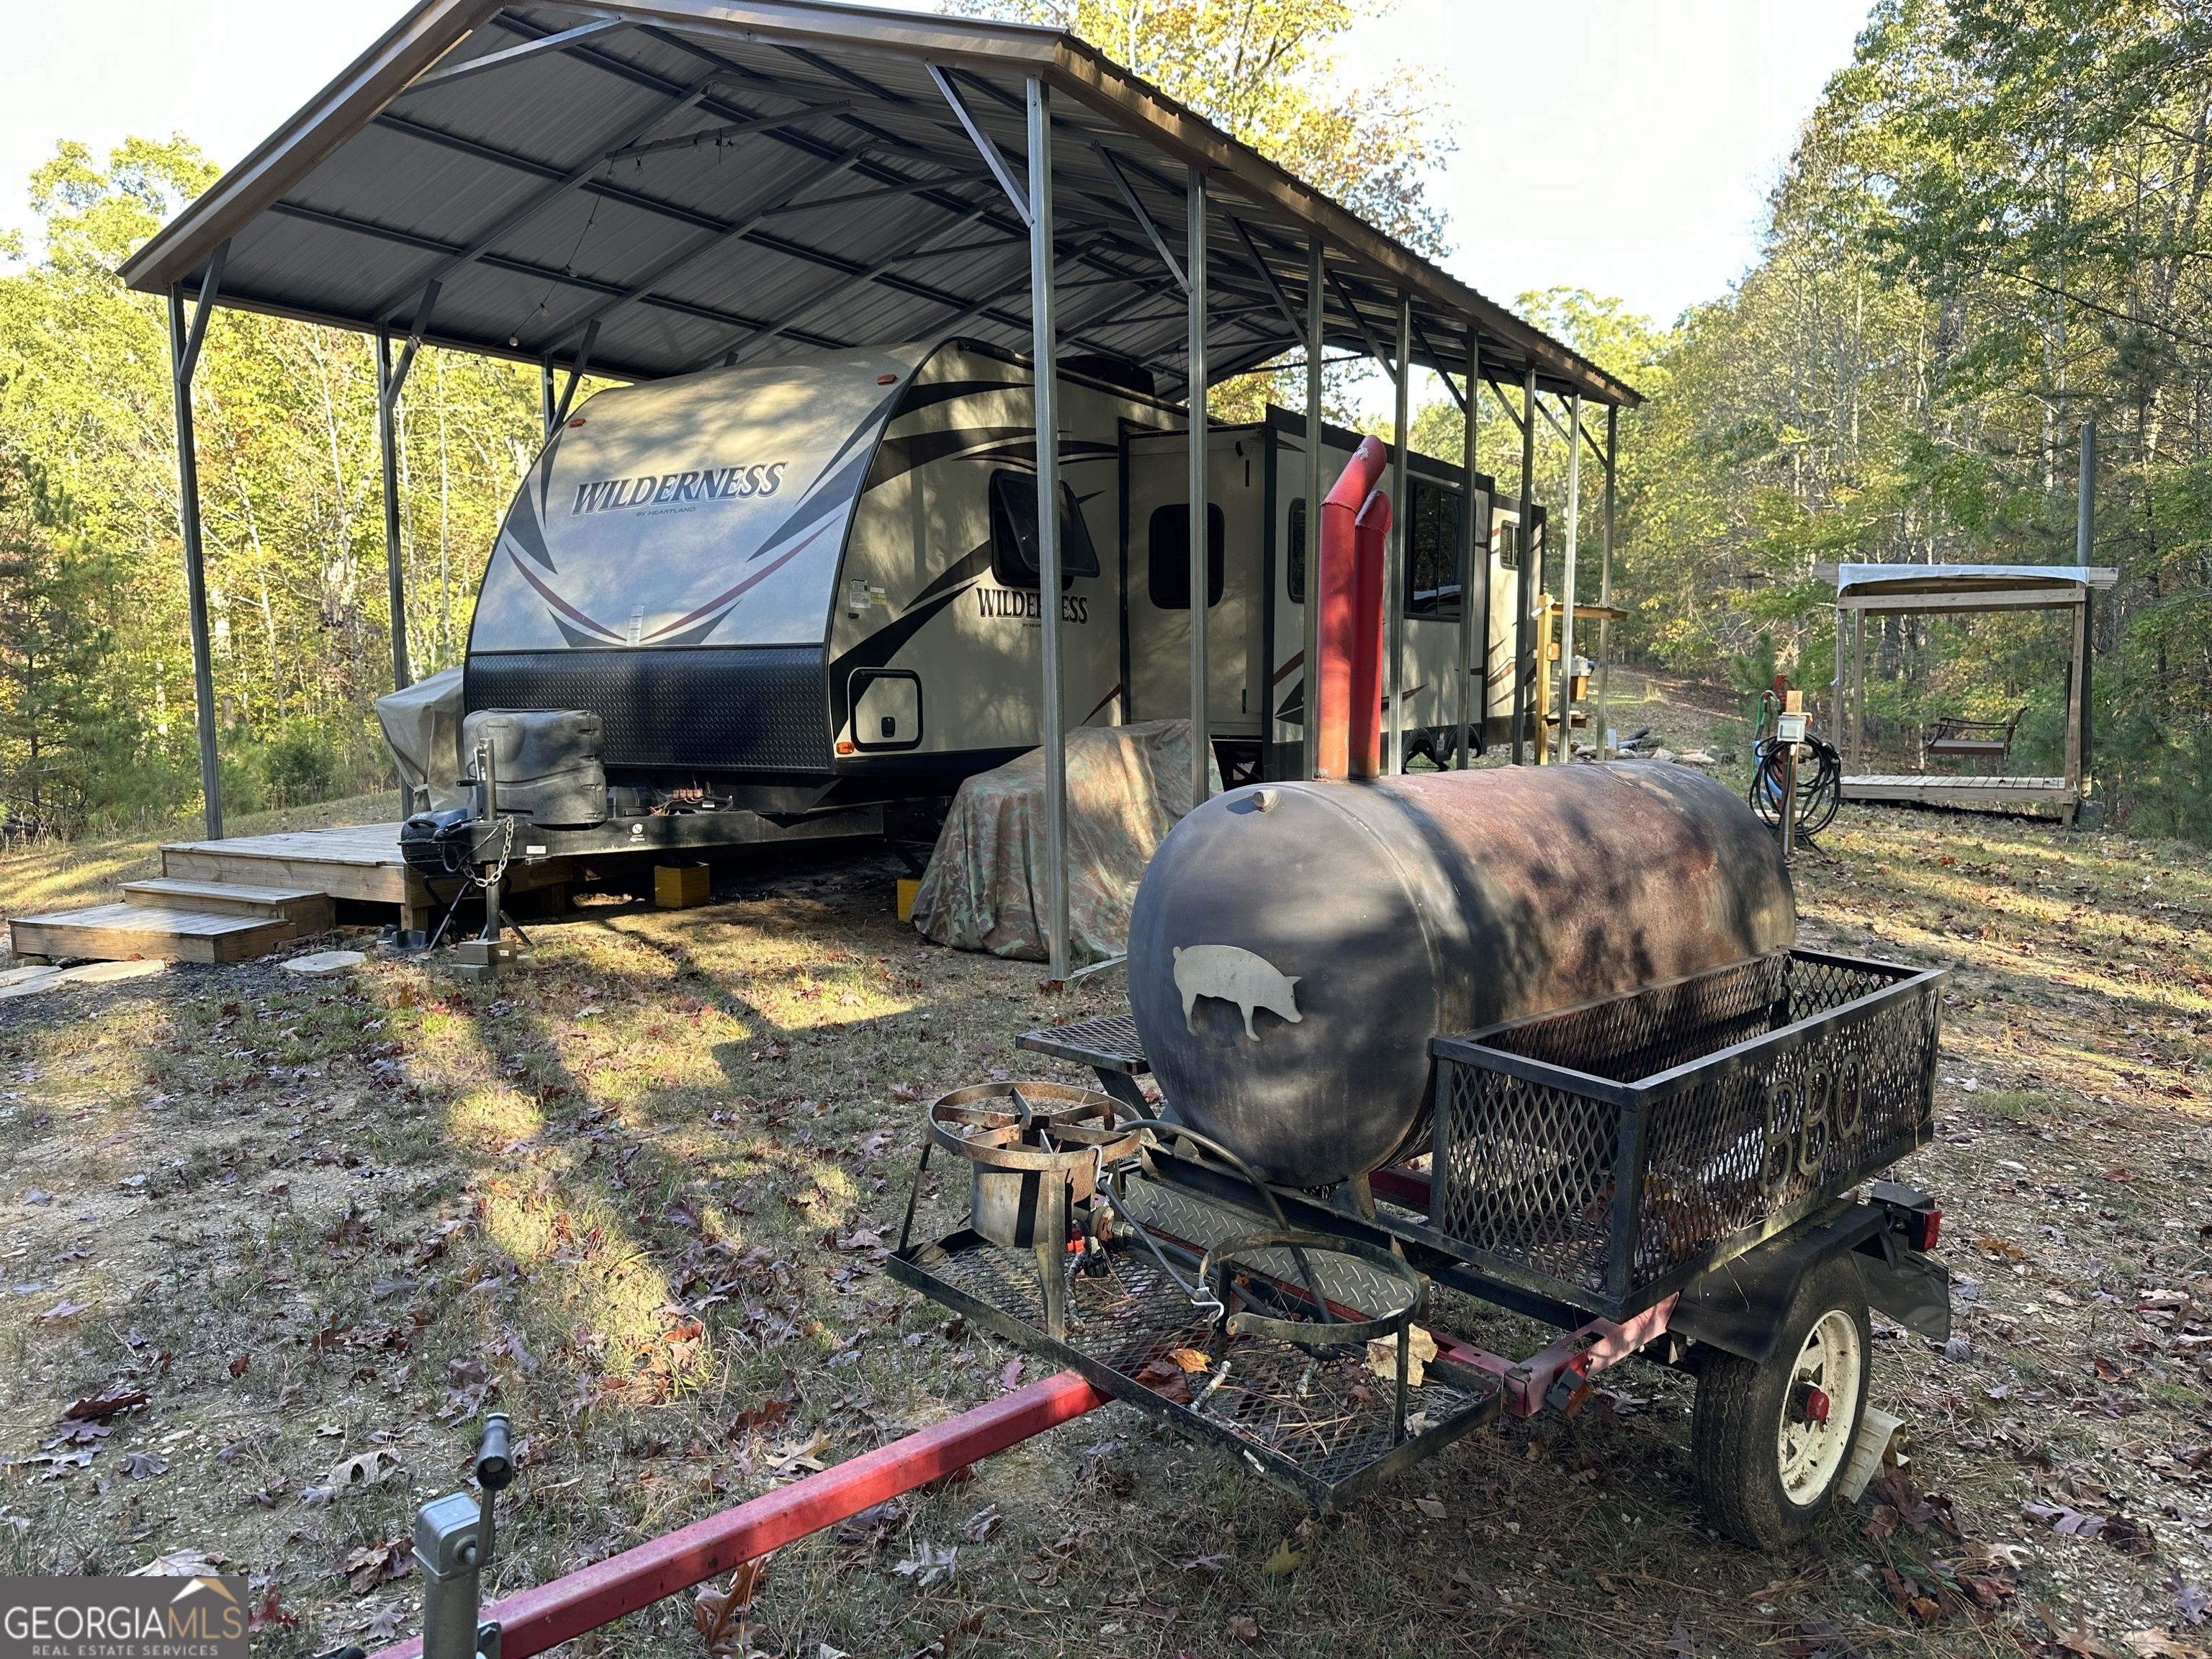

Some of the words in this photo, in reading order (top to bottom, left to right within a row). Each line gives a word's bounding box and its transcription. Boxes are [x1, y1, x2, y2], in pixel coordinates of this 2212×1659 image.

[571, 461, 788, 516] WILDERNESS
[648, 506, 696, 516] HEARTLAND
[976, 587, 1089, 624] WILDEESS
[1757, 1053, 1863, 1198] BBQ
